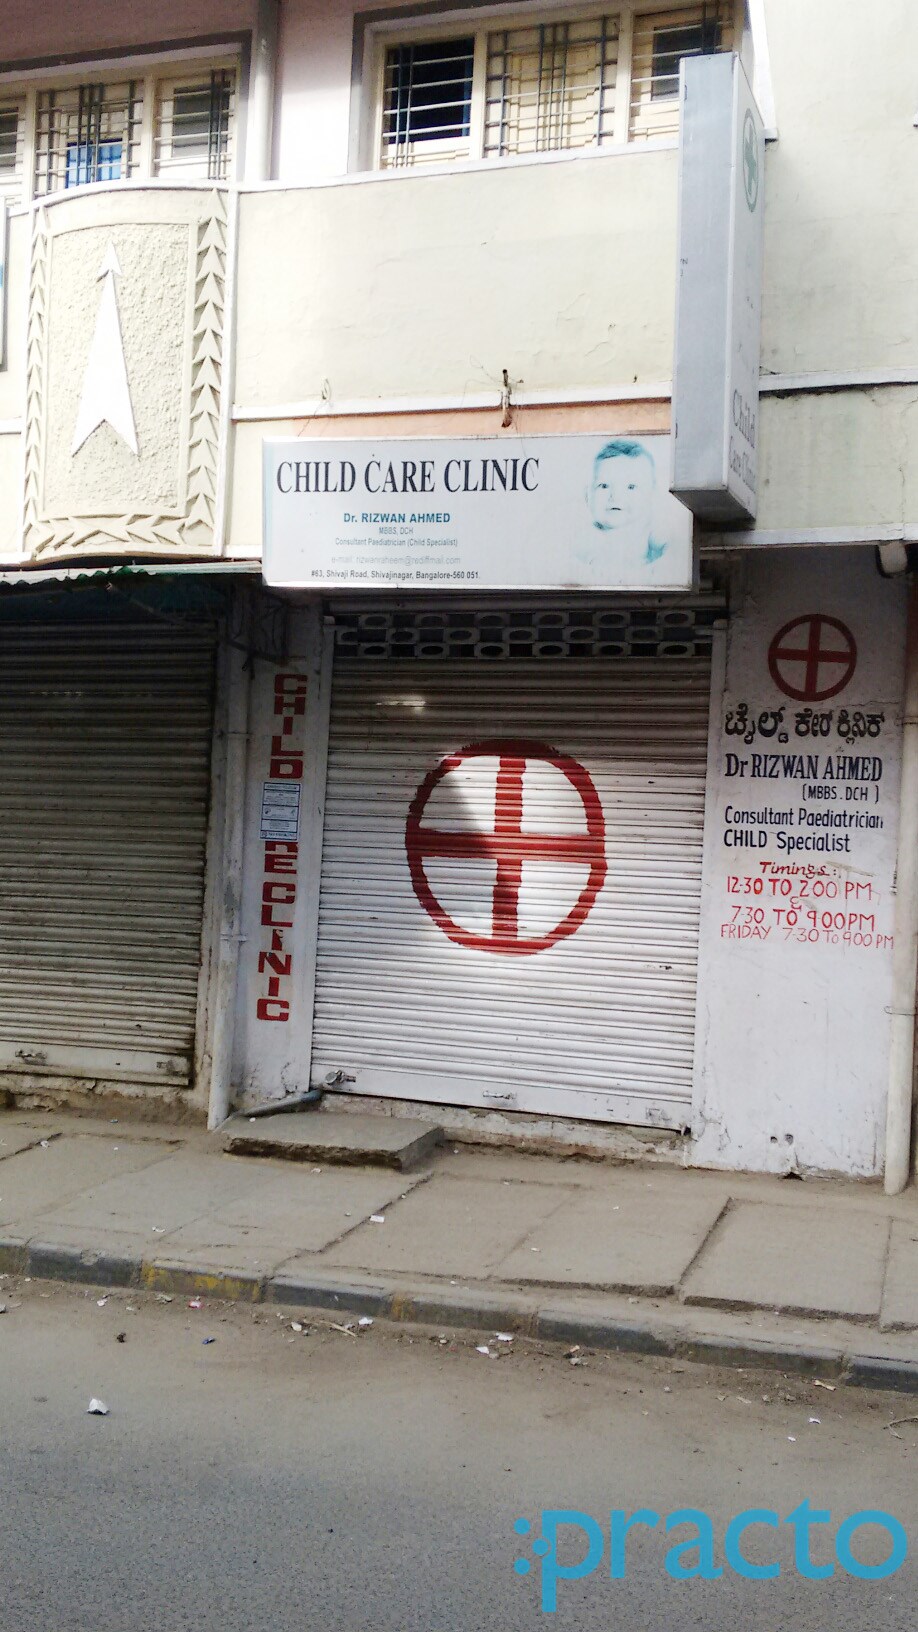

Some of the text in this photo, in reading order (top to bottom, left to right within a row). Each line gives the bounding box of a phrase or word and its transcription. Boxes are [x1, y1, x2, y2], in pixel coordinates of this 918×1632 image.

[276, 457, 539, 493] CHILD CARE CLINIC
[343, 513, 451, 523] Dr. RIZWAN AHMED
[335, 538, 458, 547] Consultant Paediatrician (Child Specialist)
[400, 527, 414, 535] DCH
[326, 570, 349, 579] Shivaji
[371, 571, 414, 580] Shivajinagar,
[269, 674, 307, 779] CHILD
[724, 753, 883, 782] Dr RIZWAN AHMED
[724, 805, 884, 829] Consultant Paediatrician
[723, 829, 851, 855] CHILD Specialist
[768, 878, 792, 896] TO
[845, 881, 872, 900] PM
[772, 908, 798, 926] TO
[720, 924, 771, 940] FRIDAY
[876, 934, 895, 950] PM
[257, 881, 296, 1021] CLINIC
